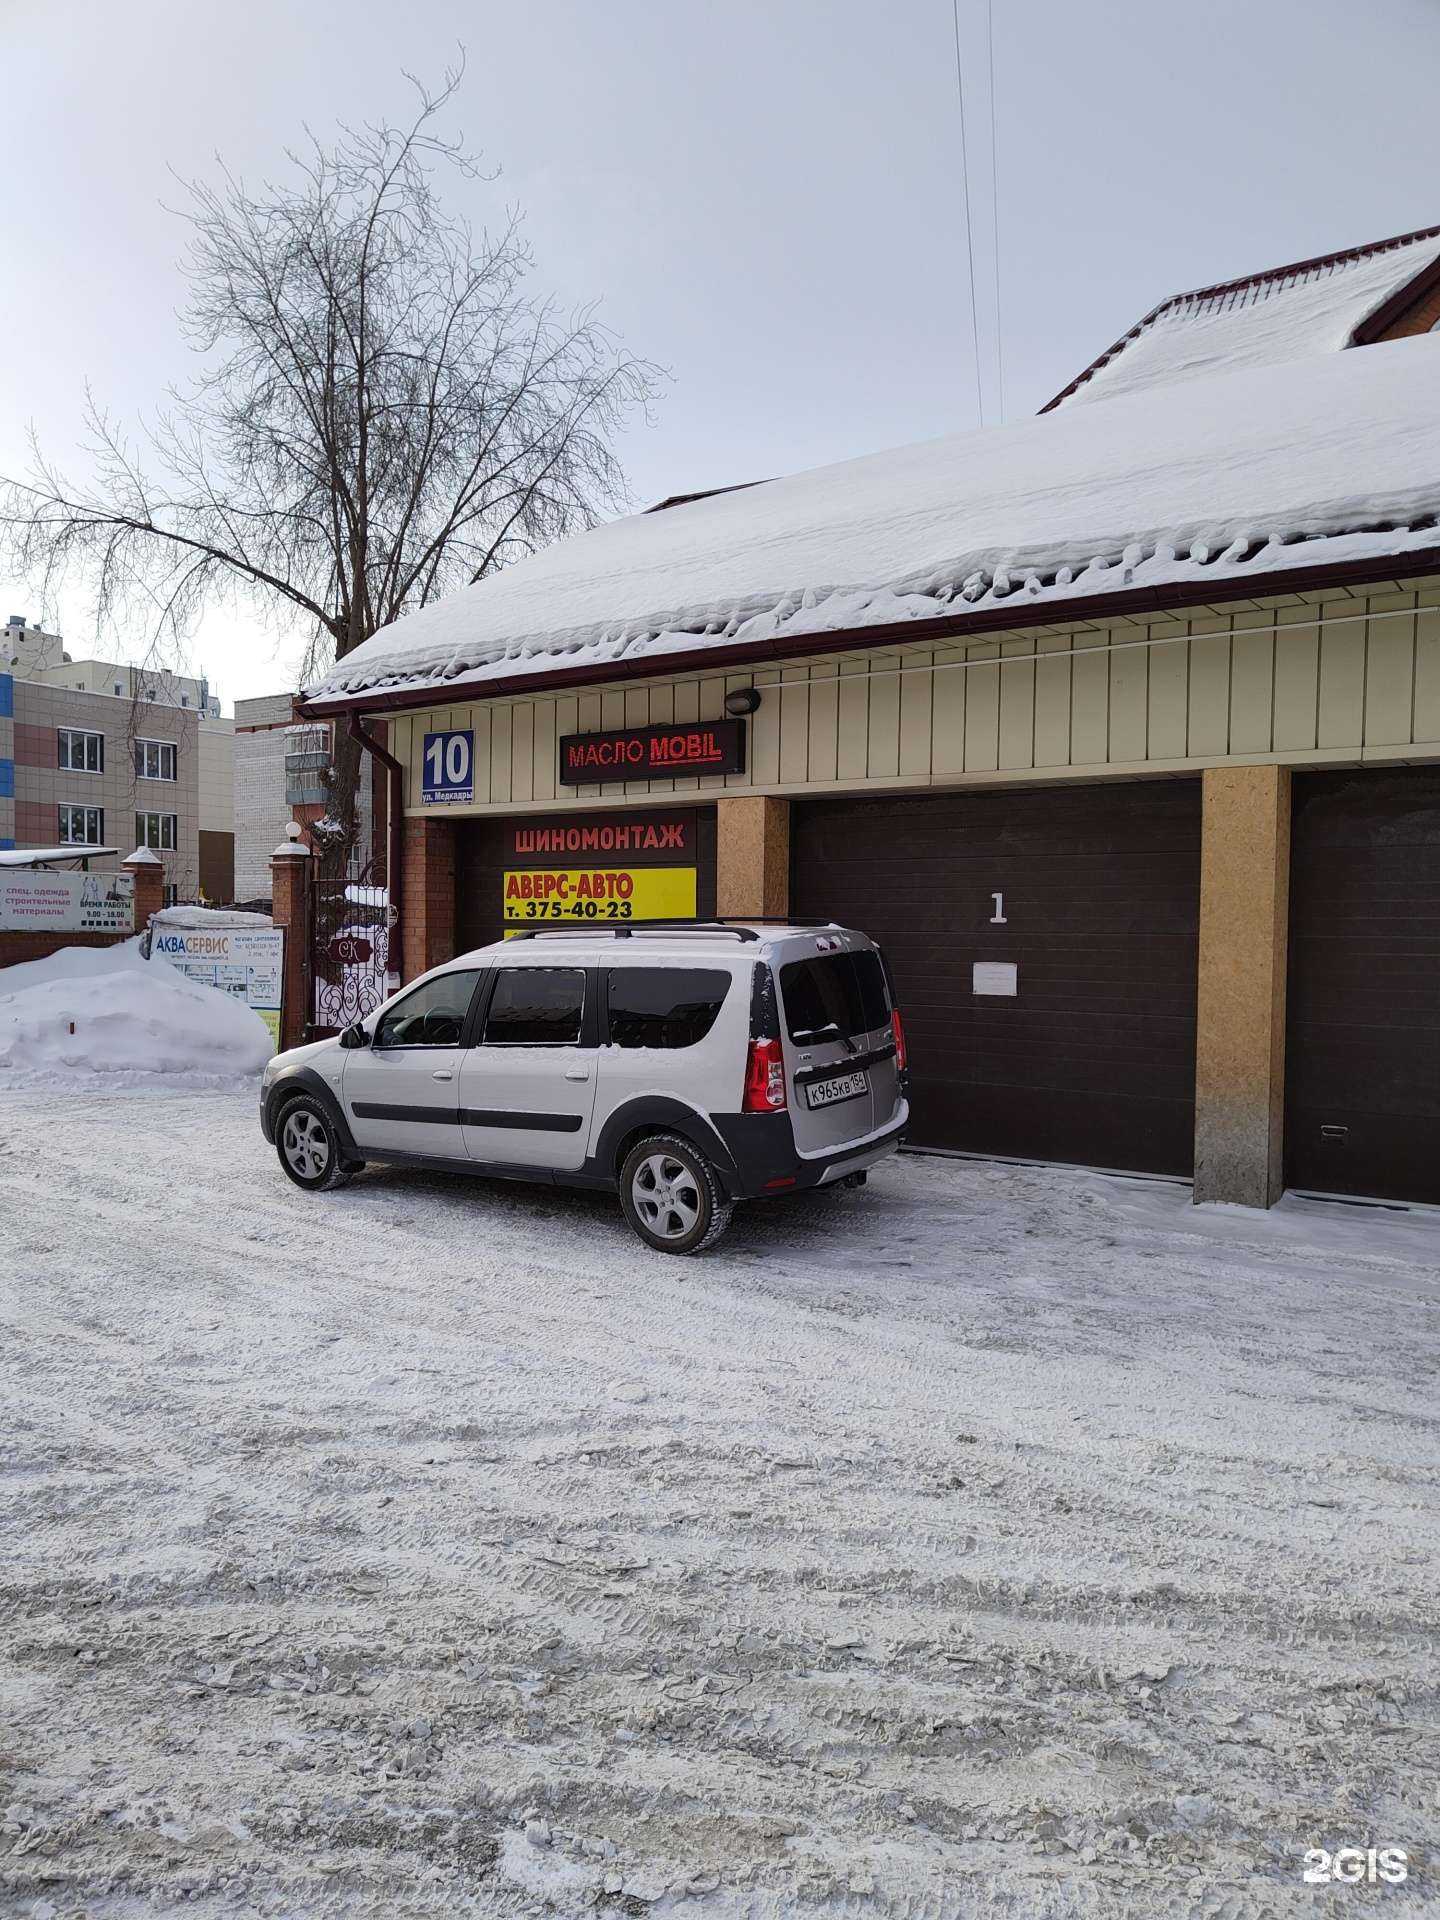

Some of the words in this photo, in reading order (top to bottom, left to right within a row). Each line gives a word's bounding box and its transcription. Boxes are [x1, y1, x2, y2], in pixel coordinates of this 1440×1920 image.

[426, 734, 470, 784] 10
[568, 740, 644, 767] МАСЛО
[649, 733, 722, 761] MOBIL
[422, 792, 433, 802] ул.
[434, 791, 473, 801] Медкадры
[515, 824, 685, 853] ШИНОМОНТАЖ
[6, 888, 32, 897] спец.
[34, 888, 70, 897] одежда
[506, 872, 634, 900] АВЕРС-АВТО
[5, 897, 72, 906] строительные
[80, 901, 103, 909] ВРЕМЯ
[104, 901, 131, 909] РАБОТЫ
[506, 906, 519, 918] т.
[525, 901, 632, 919] 375-40-23
[990, 892, 1007, 923] 1
[12, 908, 65, 917] материалы
[86, 910, 101, 918] 9.00
[156, 935, 229, 954] АКВАСЕРВИС
